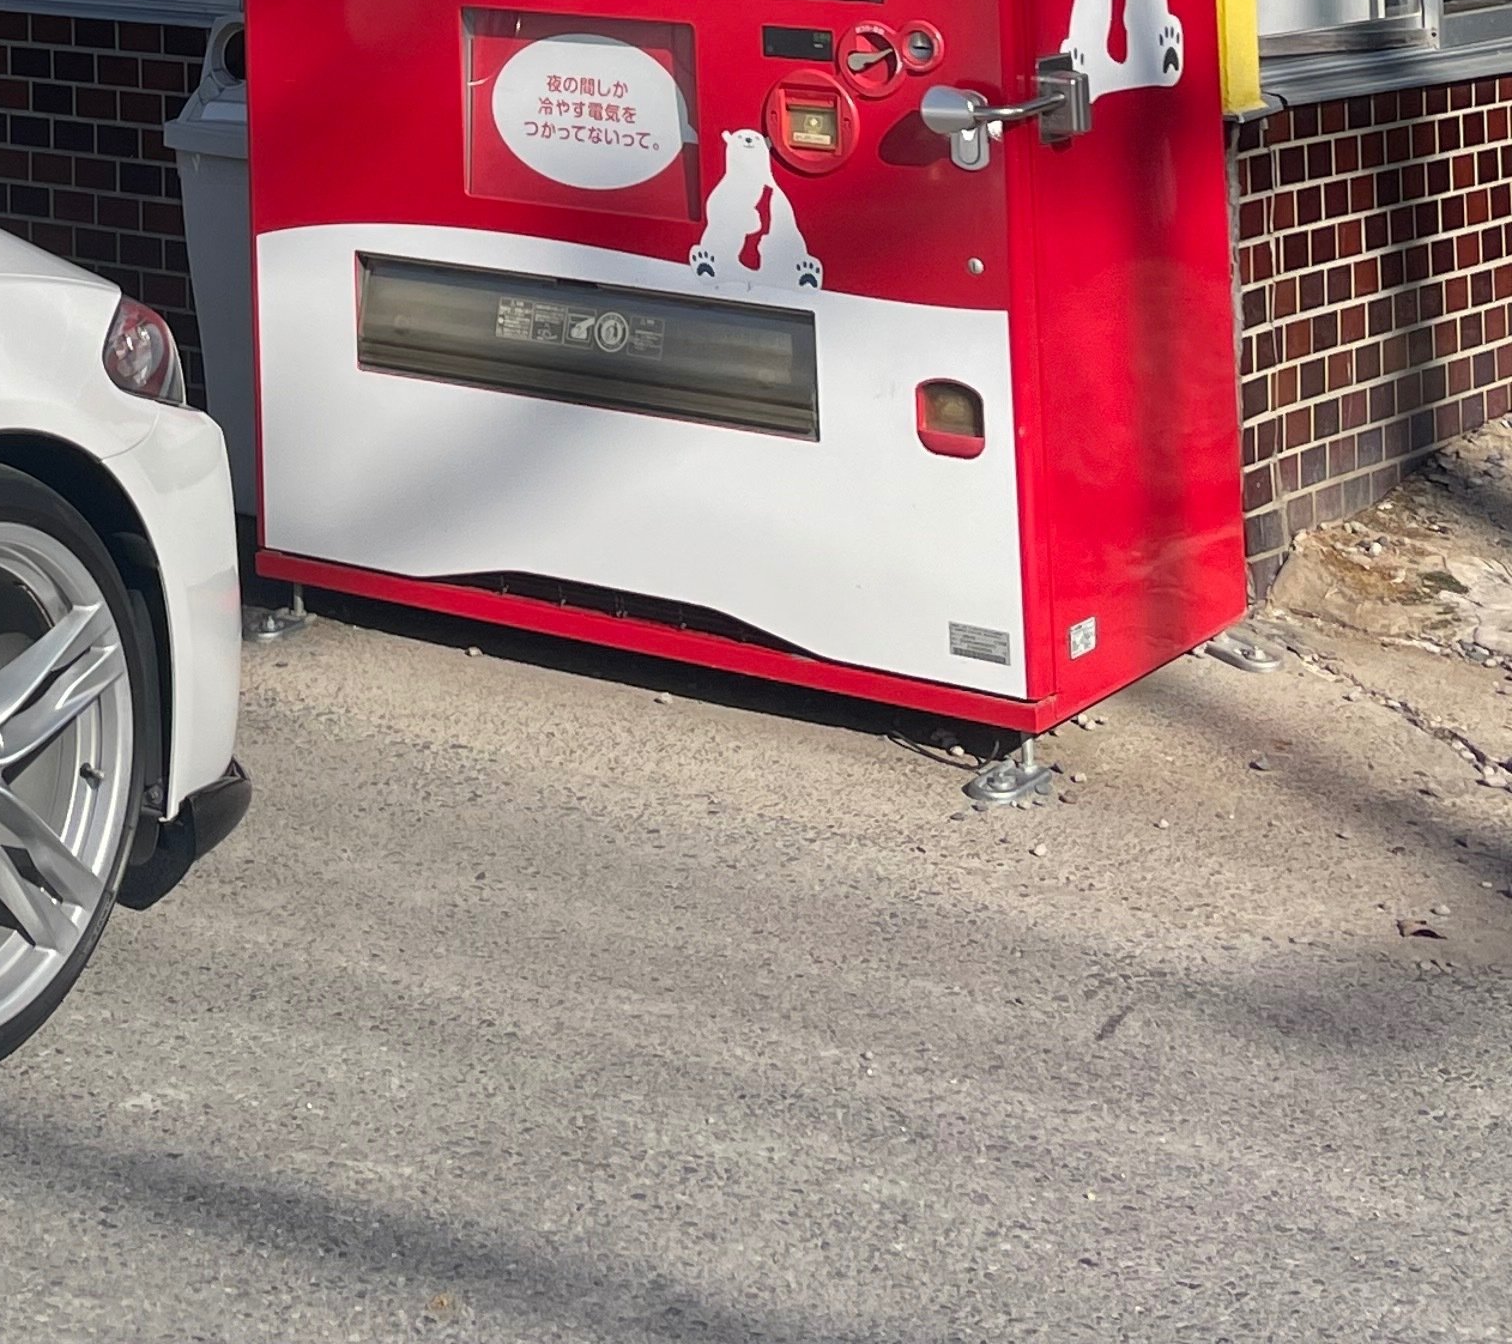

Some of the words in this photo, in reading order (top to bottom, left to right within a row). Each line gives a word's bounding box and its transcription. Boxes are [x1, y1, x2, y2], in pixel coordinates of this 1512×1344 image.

[546, 74, 629, 99] 夜の間しか
[538, 97, 637, 125] 冷やす電気を
[524, 121, 660, 151] つかってないって。
